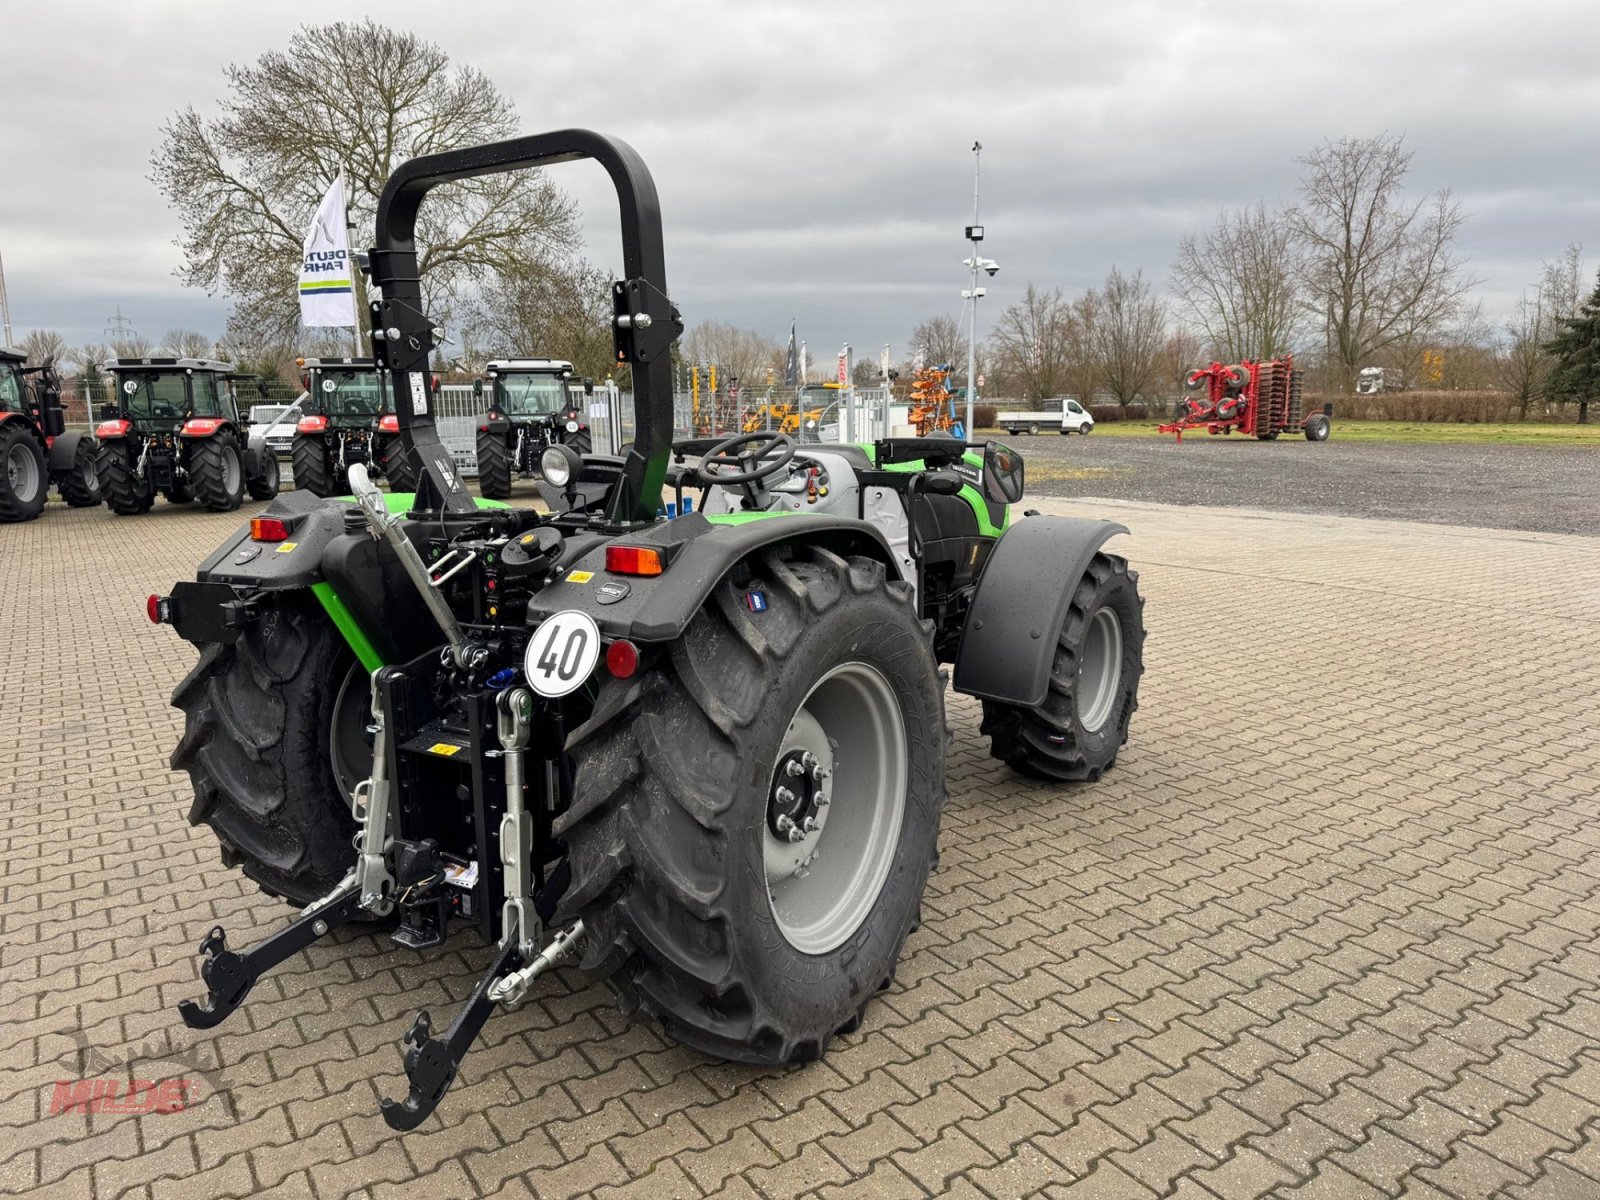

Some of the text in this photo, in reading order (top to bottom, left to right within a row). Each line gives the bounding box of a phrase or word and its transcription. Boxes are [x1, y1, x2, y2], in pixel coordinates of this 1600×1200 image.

[126, 383, 135, 392] 40
[324, 382, 333, 390] 40
[536, 624, 588, 681] 40
